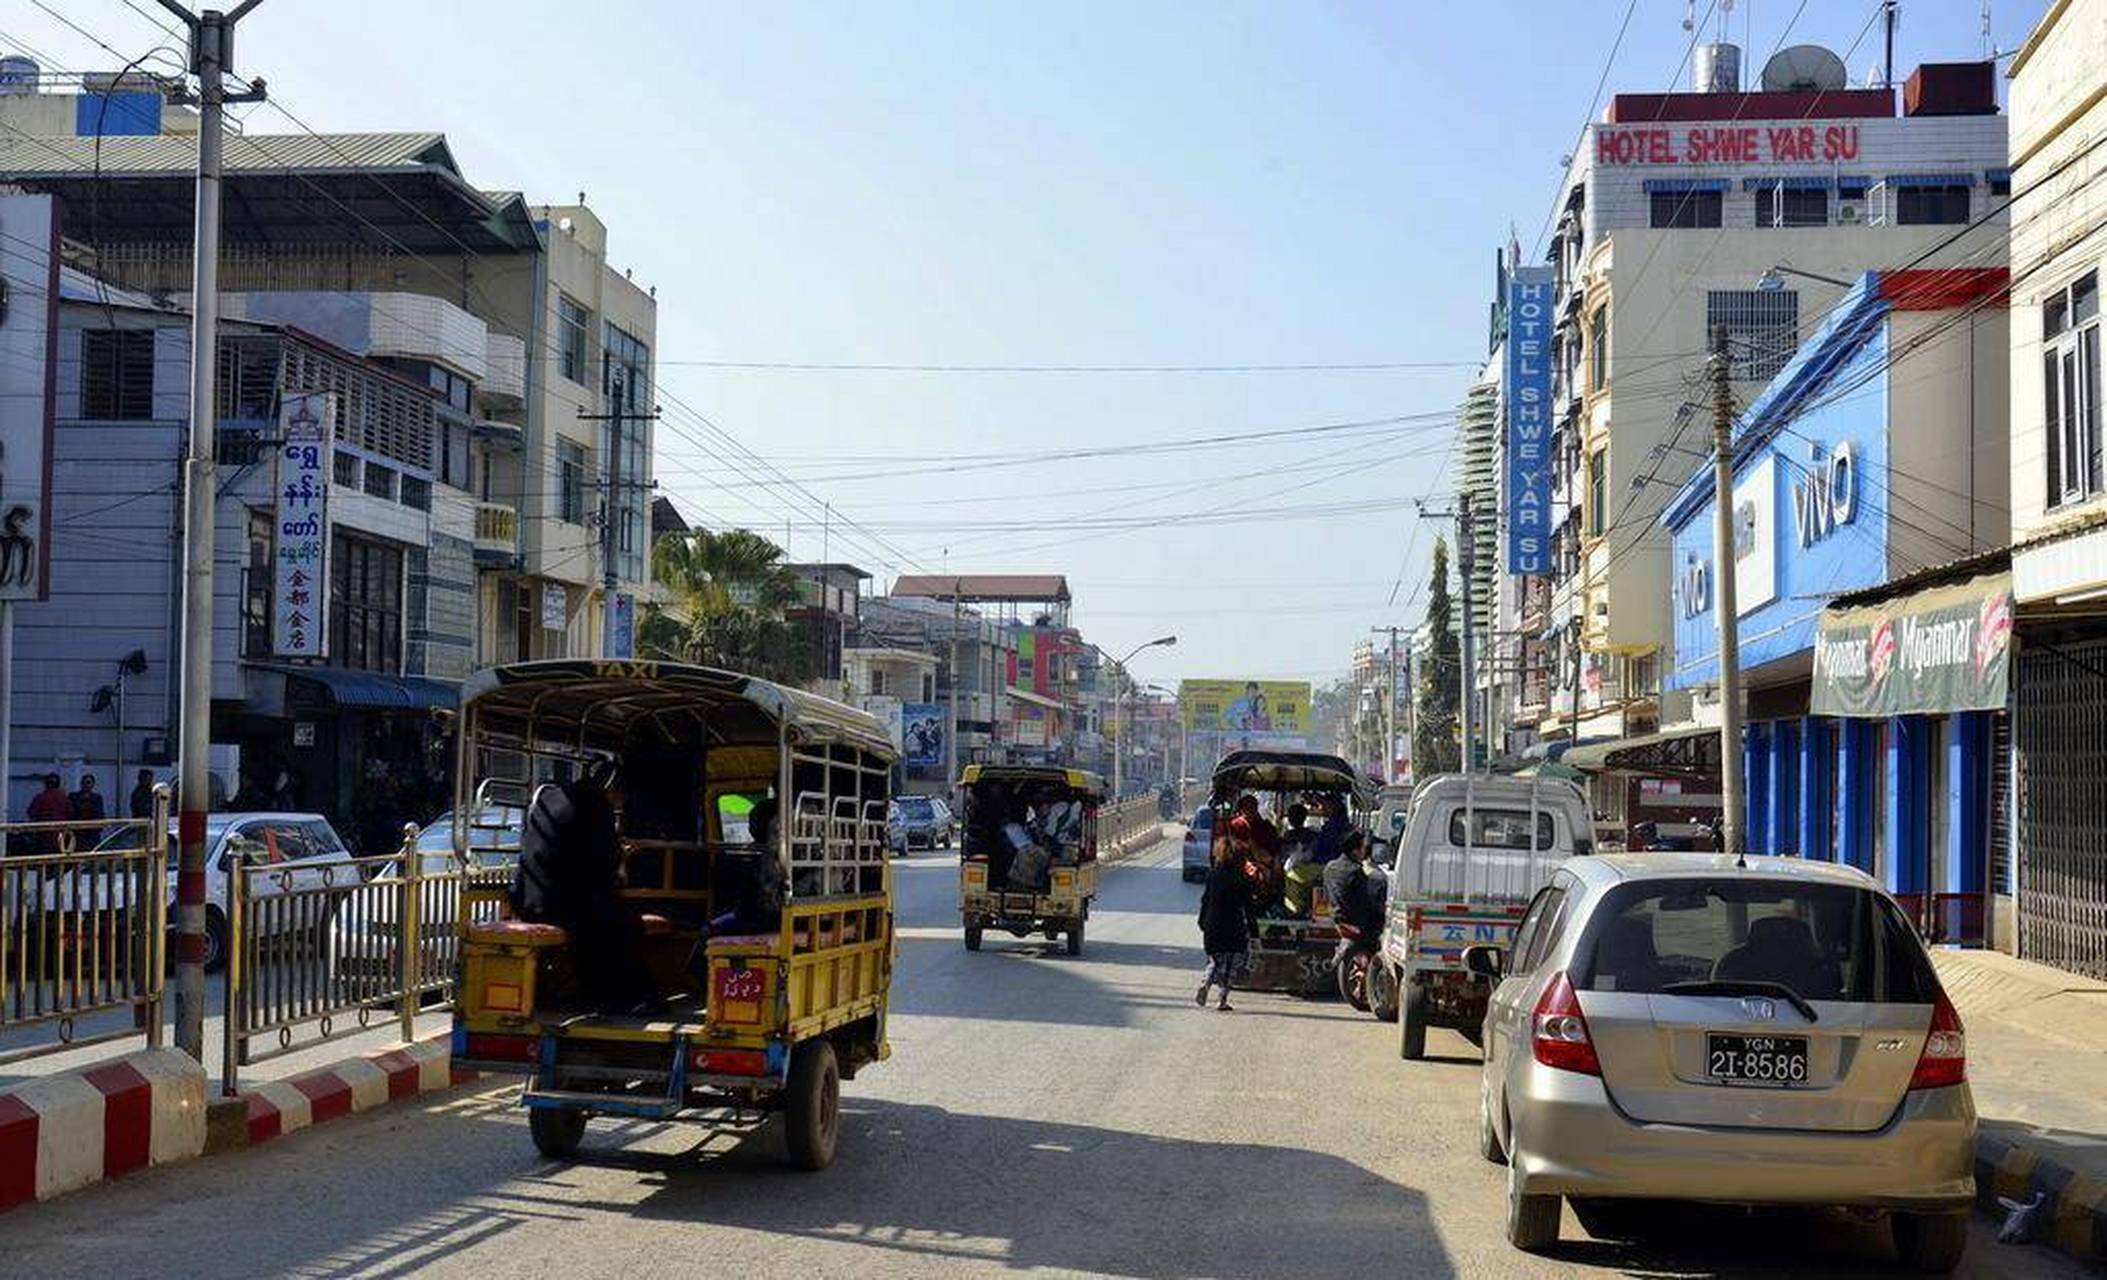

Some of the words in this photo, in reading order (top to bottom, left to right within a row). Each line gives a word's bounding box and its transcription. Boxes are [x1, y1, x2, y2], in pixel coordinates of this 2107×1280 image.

[1599, 130, 1677, 164] HOTEL
[1688, 128, 1759, 162] SHWE
[1767, 127, 1815, 161] YAR
[1824, 125, 1859, 160] SU
[1520, 284, 1541, 375] HOTEL
[1518, 387, 1542, 459] SHWE
[1519, 471, 1540, 525] YAR
[1792, 441, 1852, 549] vivo
[1519, 537, 1540, 572] SU
[592, 662, 657, 679] TAXI
[1900, 614, 1975, 680] Myanmar
[1743, 1037, 1775, 1050] YGN
